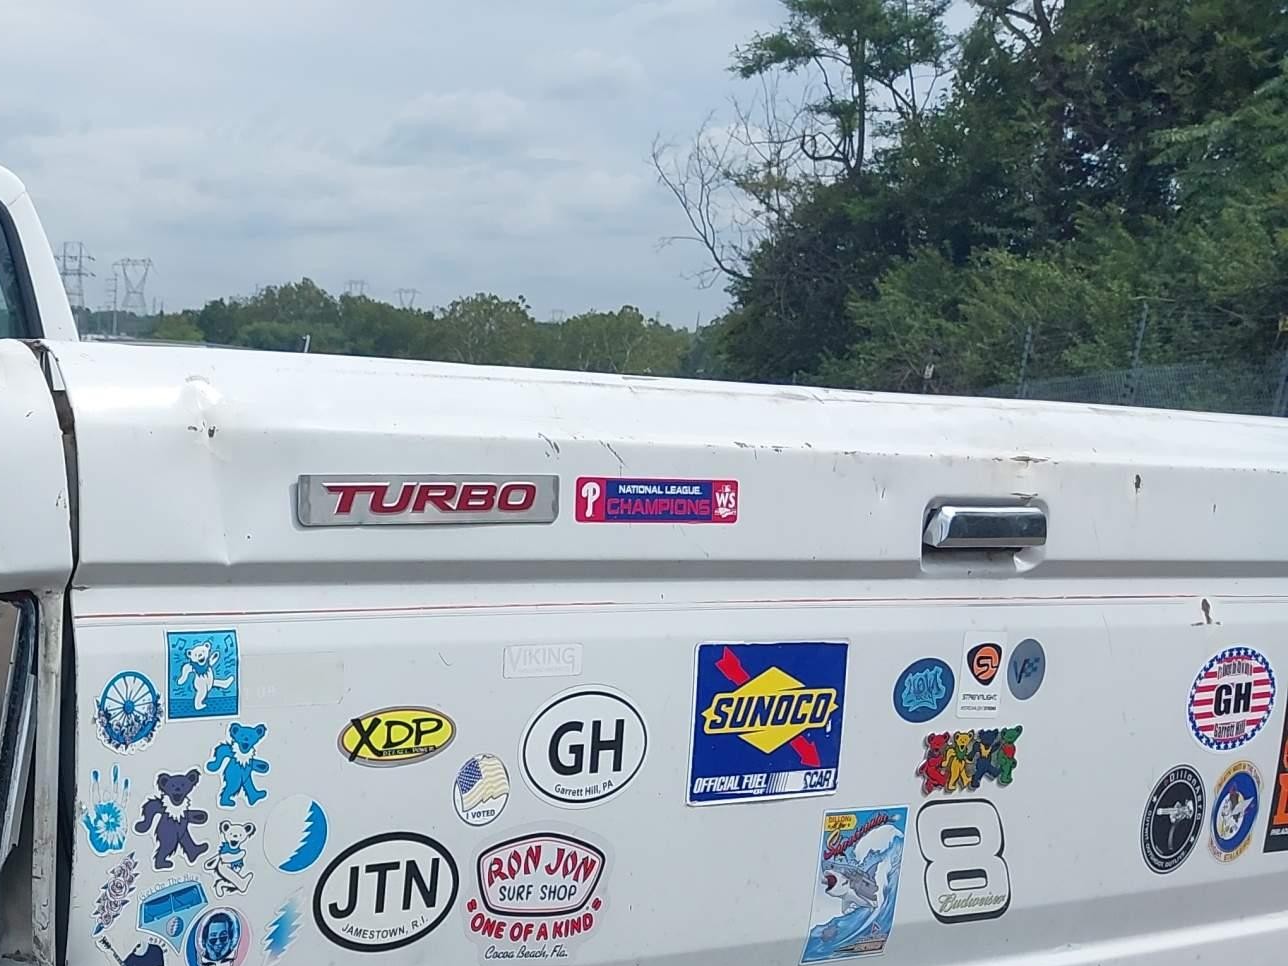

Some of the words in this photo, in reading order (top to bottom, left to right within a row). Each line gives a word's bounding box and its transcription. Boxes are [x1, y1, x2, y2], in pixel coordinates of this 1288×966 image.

[321, 482, 537, 515] TURBO
[618, 484, 664, 495] NATIONAL
[665, 485, 702, 495] LEAGUE
[607, 497, 711, 516] CHAMPIONS
[506, 647, 576, 673] VIKING
[709, 692, 833, 731] SUNOCO
[1213, 682, 1253, 717] GH
[348, 717, 444, 762] XDP
[548, 718, 626, 776] GH
[554, 783, 584, 797] Garrett
[585, 784, 601, 797] Hill,
[601, 780, 613, 794] PA
[693, 775, 740, 794] OFFICIAL
[741, 772, 768, 790] FUEL
[471, 809, 496, 819] VOTED
[488, 845, 542, 888] RON
[545, 847, 597, 883] JON
[916, 798, 1011, 924] 8
[328, 857, 440, 919] JTN
[499, 884, 533, 902] SURF
[539, 884, 577, 901] SHOP
[938, 891, 1006, 913] Budweiser
[341, 922, 409, 940] JAMESTOWN,
[411, 915, 429, 931] R.I.
[509, 921, 534, 942] OF
[535, 922, 549, 941] A
[484, 946, 515, 960] Cocoa
[516, 944, 549, 959] Beach,
[550, 944, 568, 959] Fla.
